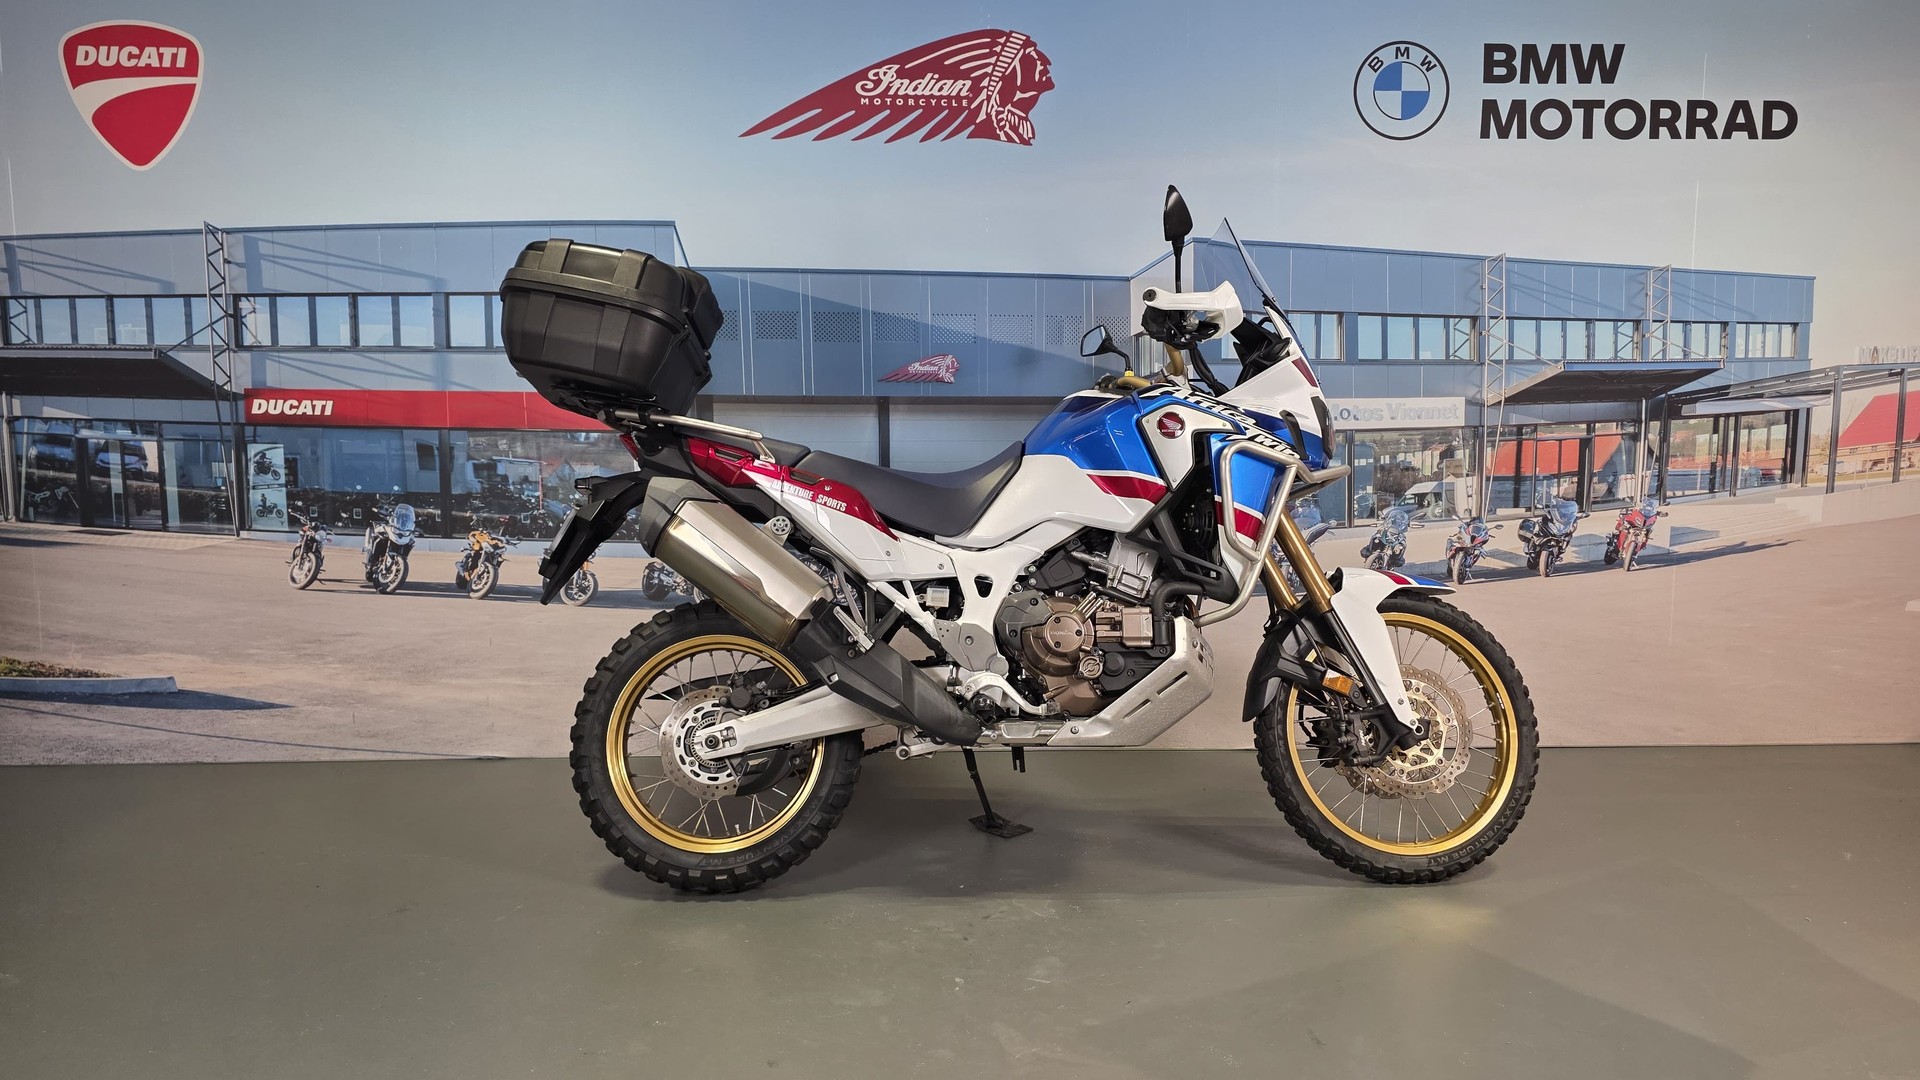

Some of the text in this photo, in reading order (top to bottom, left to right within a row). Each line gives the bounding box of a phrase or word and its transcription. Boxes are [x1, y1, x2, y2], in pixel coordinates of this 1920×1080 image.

[75, 45, 187, 68] DUCATI
[1367, 45, 1438, 74] BMW
[1482, 43, 1625, 84] BMW
[855, 64, 971, 97] Indian
[860, 97, 968, 107] MOTORCYCLE
[1479, 98, 1798, 141] MOTORRAD
[908, 362, 939, 371] Indian
[251, 399, 333, 415] DUCATI
[1386, 402, 1459, 420] Vionnet
[771, 480, 848, 512] ADVENTURE SPORTS
